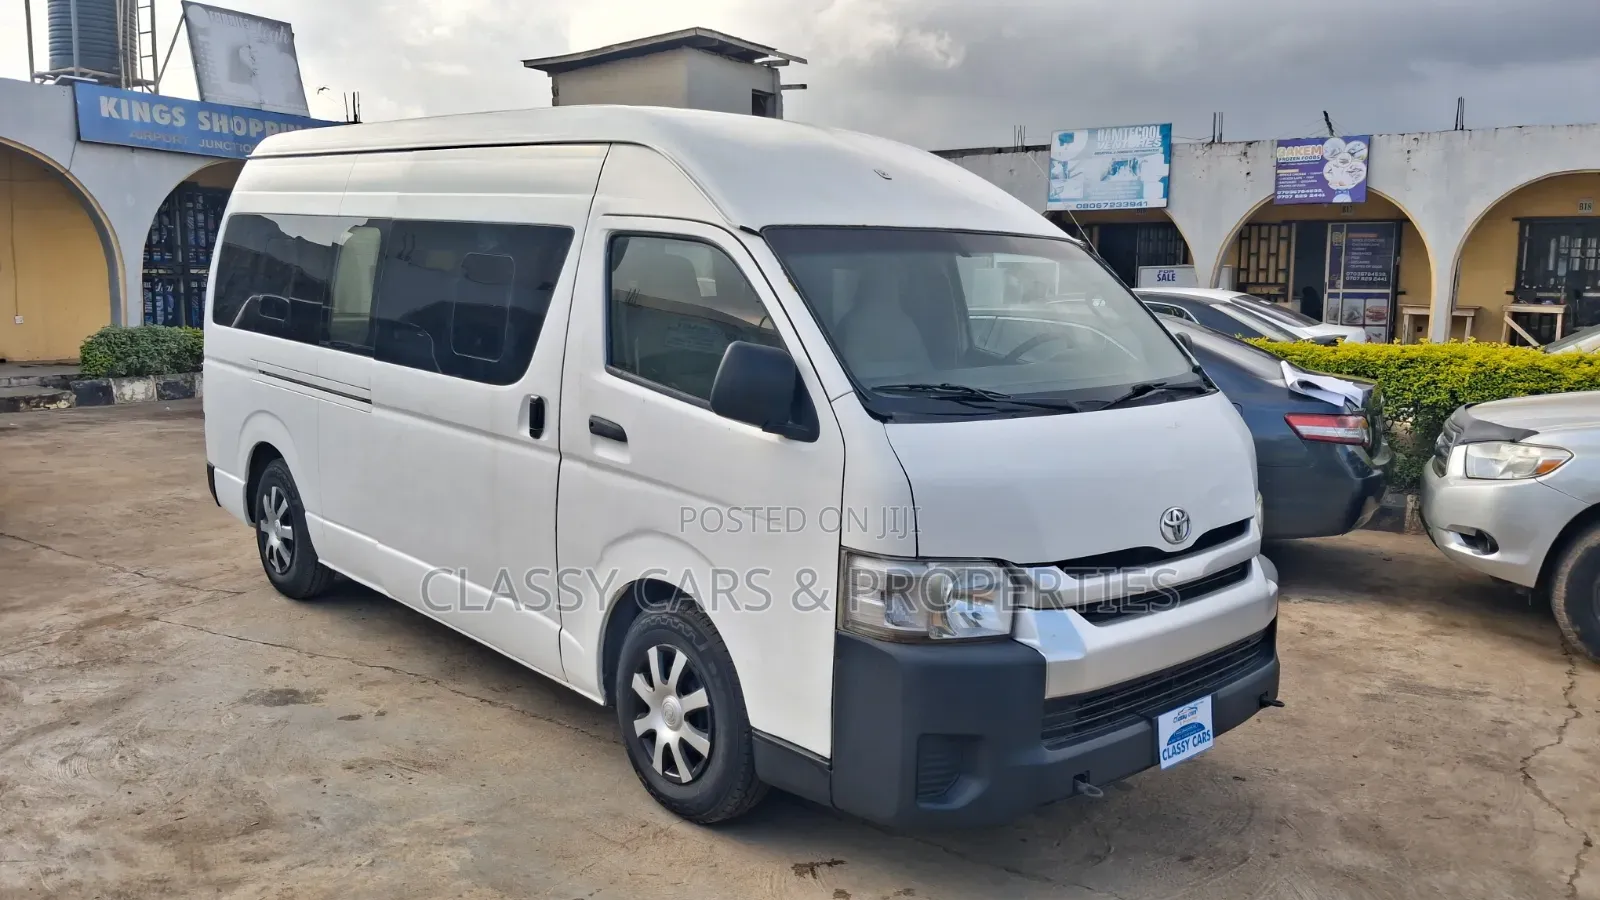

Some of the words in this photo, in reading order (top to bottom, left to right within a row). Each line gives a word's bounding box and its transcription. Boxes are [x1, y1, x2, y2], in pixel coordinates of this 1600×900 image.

[99, 96, 186, 127] KINGS
[130, 131, 188, 145] AIRPORT
[199, 139, 255, 153] JUNCTIO
[1156, 273, 1176, 282] SALE
[1162, 737, 1190, 761] CLASSY
[1192, 730, 1211, 748] CARS
